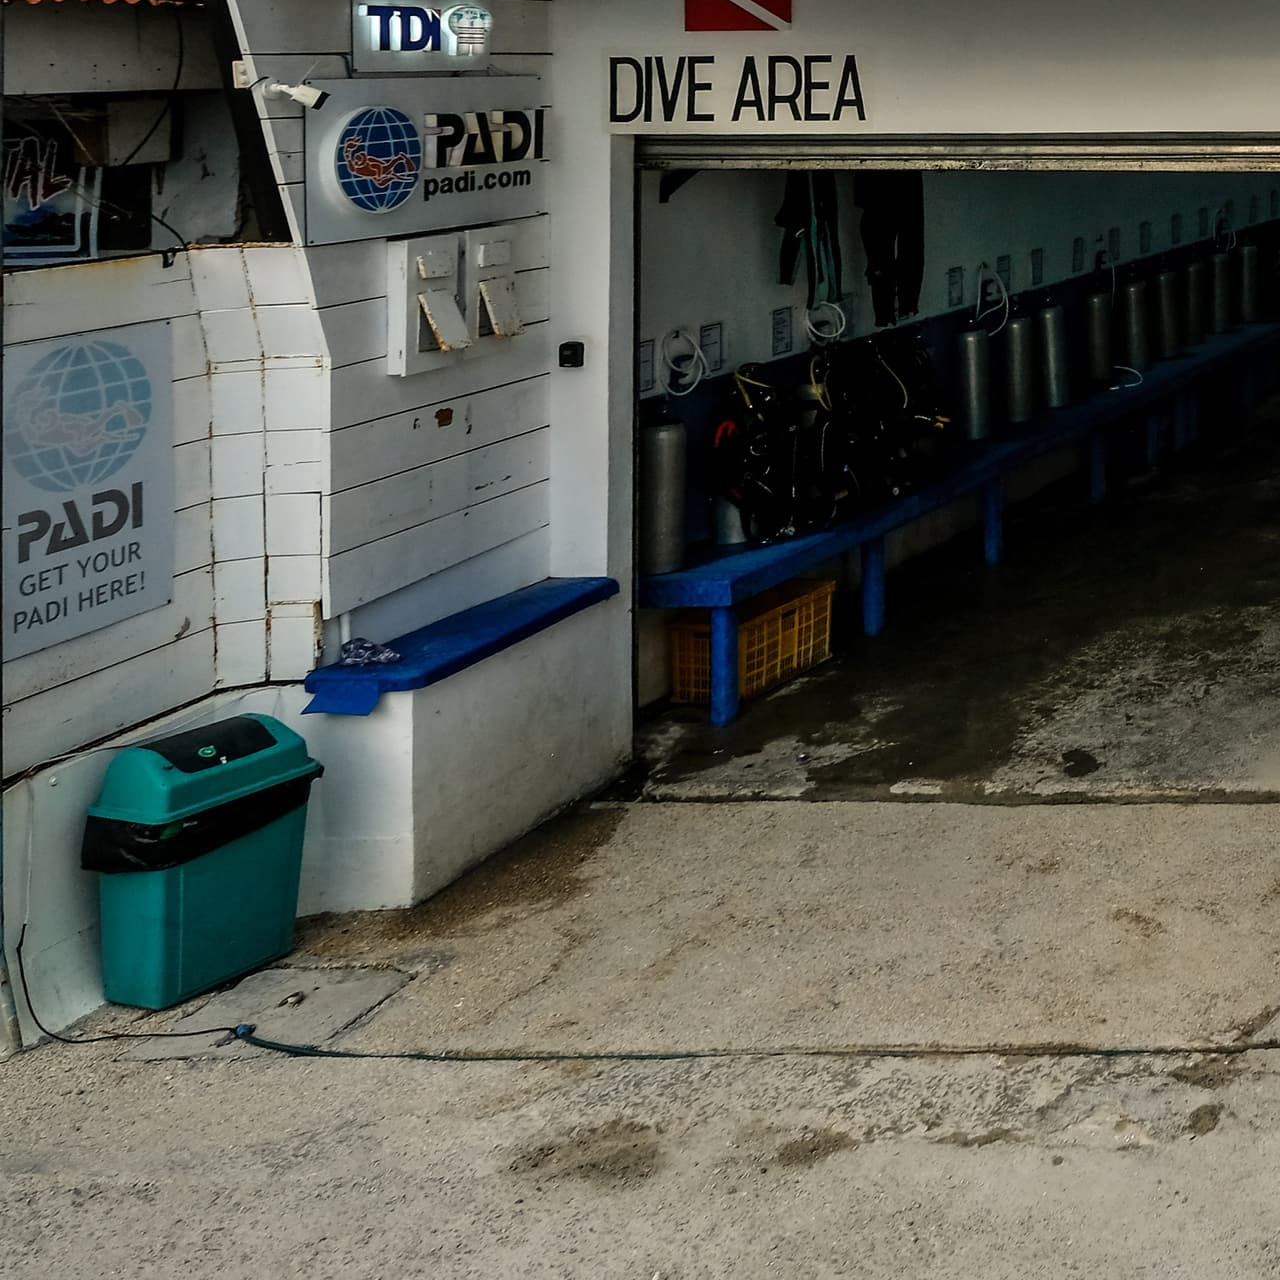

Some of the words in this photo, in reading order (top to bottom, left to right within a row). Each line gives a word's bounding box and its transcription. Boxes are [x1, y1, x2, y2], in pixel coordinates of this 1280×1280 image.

[360, 4, 442, 51] TDI
[610, 56, 714, 122] DIVE
[731, 55, 866, 121] AREA
[425, 109, 545, 168] PADI
[424, 167, 532, 202] padi.com
[18, 481, 143, 564] PADI
[19, 563, 69, 597] GET
[77, 541, 142, 578] YOUR
[13, 596, 68, 634] PADI
[78, 571, 145, 612] HERE!
